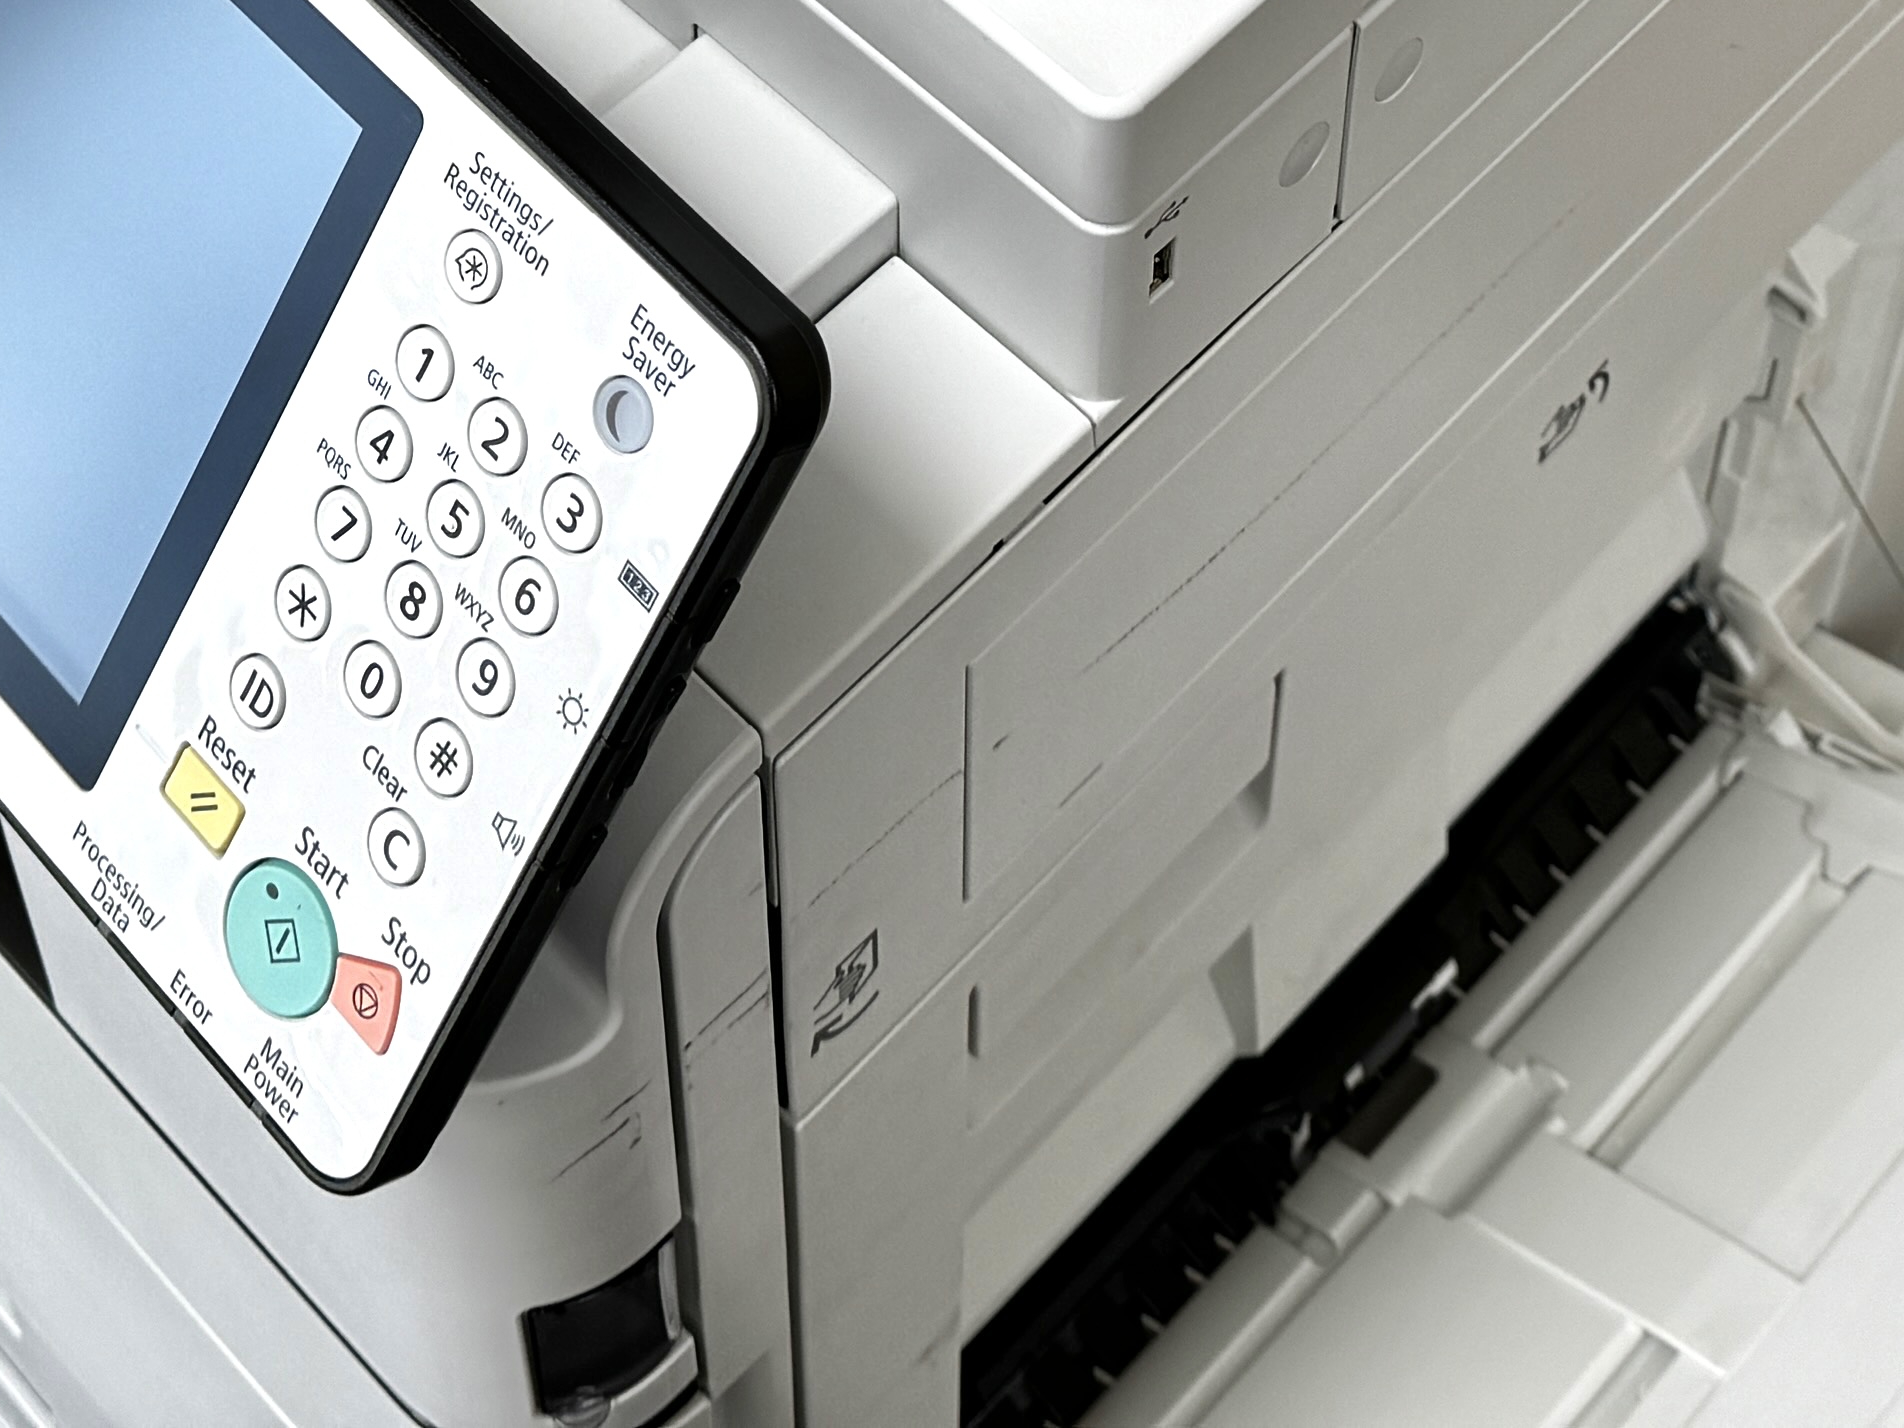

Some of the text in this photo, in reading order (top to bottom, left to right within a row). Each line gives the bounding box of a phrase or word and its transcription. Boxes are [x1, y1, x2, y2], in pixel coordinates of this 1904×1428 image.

[468, 151, 553, 235] Settings/
[443, 162, 548, 276] Registration
[630, 303, 695, 379] Energy
[367, 369, 391, 400] GHI
[415, 348, 434, 382] 1
[472, 355, 504, 390] ABC
[622, 336, 682, 397] Saver
[316, 437, 351, 480] PQRS
[369, 429, 394, 464] 4
[436, 442, 459, 472] JKL
[480, 416, 509, 461] 2
[551, 432, 580, 464] DEF
[330, 505, 357, 541] 7
[440, 499, 469, 539] 5
[501, 507, 535, 549] MNO
[555, 492, 584, 533] 3
[394, 518, 422, 553] TUV
[399, 581, 426, 621] 8
[454, 582, 494, 632] WXYZ
[514, 578, 541, 615] 6
[239, 669, 273, 718] ID
[360, 662, 383, 699] 0
[471, 659, 498, 696] 9
[197, 715, 256, 794] Reset
[362, 745, 407, 802] Clear
[294, 826, 348, 899] Start
[383, 829, 410, 871] C
[72, 820, 165, 931] Processing/
[90, 877, 129, 933] Data
[381, 917, 430, 985] Stop
[169, 969, 212, 1024] Error
[243, 1053, 298, 1123] Power
[260, 1037, 303, 1098] Main
